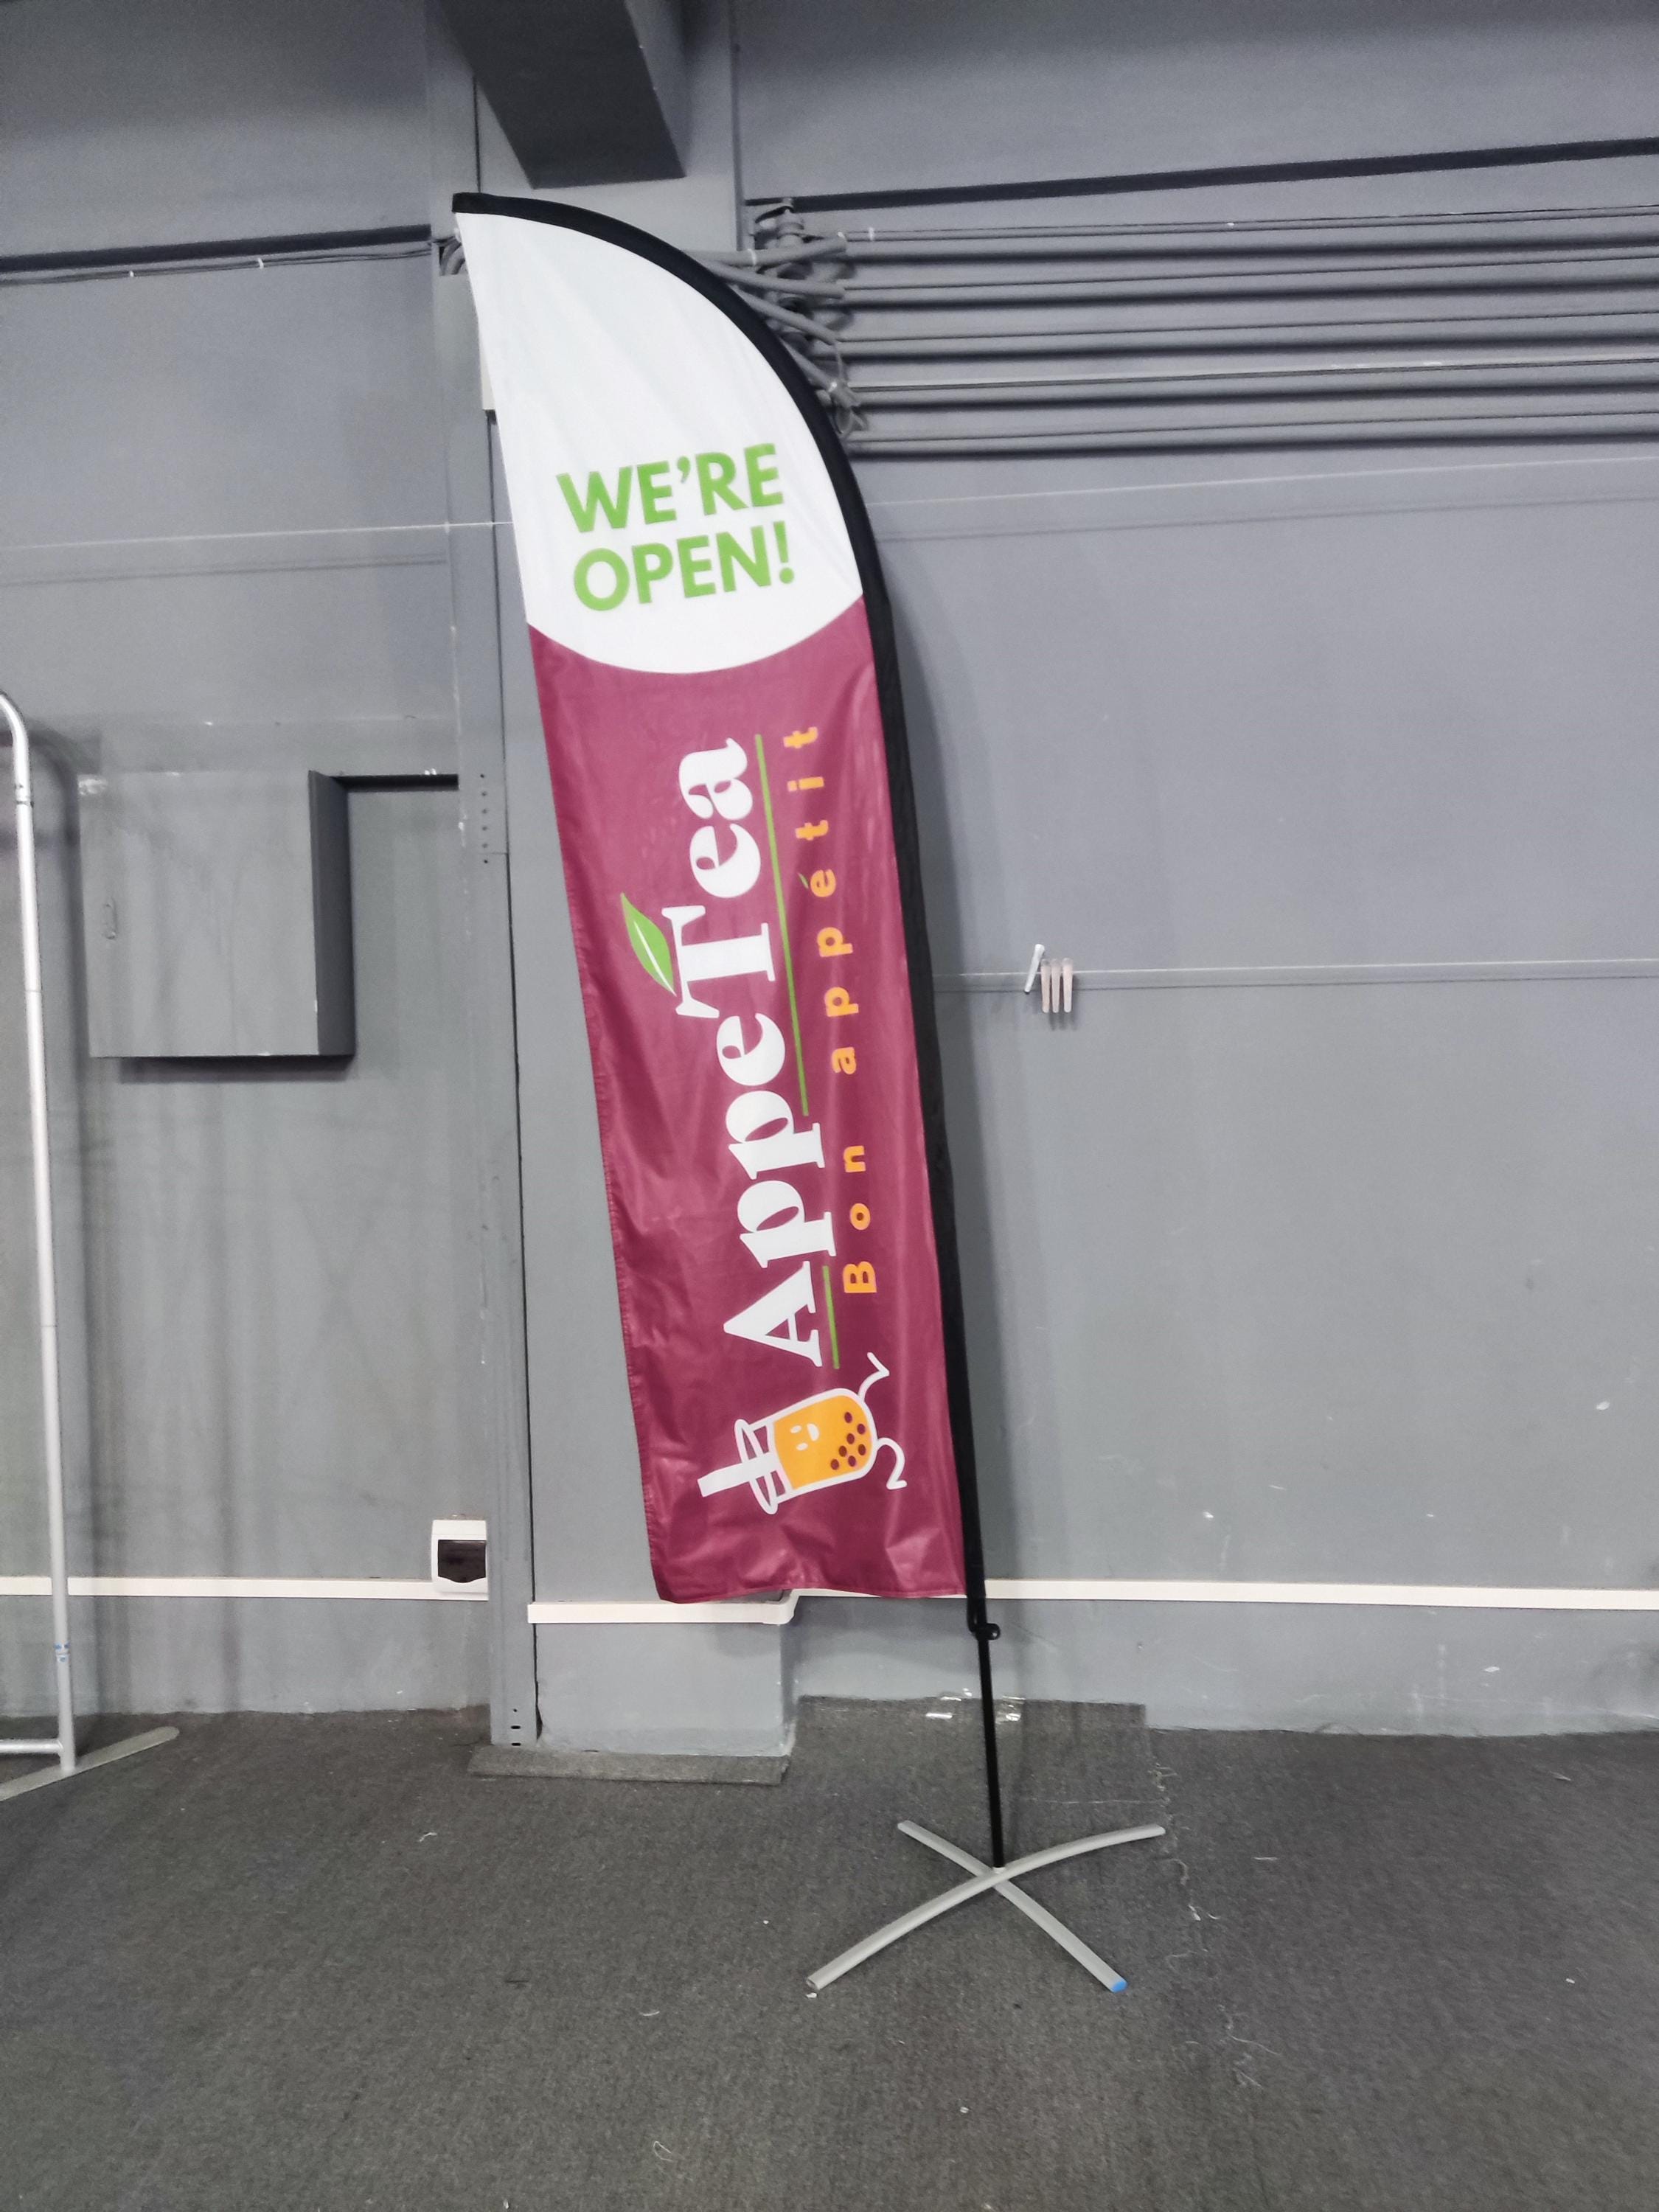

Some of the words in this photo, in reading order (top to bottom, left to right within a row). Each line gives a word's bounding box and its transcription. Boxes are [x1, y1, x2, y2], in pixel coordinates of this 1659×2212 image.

[555, 442, 785, 534] WE'RE
[573, 520, 796, 612] OPEN!
[783, 726, 860, 1075] appétit
[661, 737, 838, 1368] AppeTea
[842, 1144, 878, 1295] Bon
